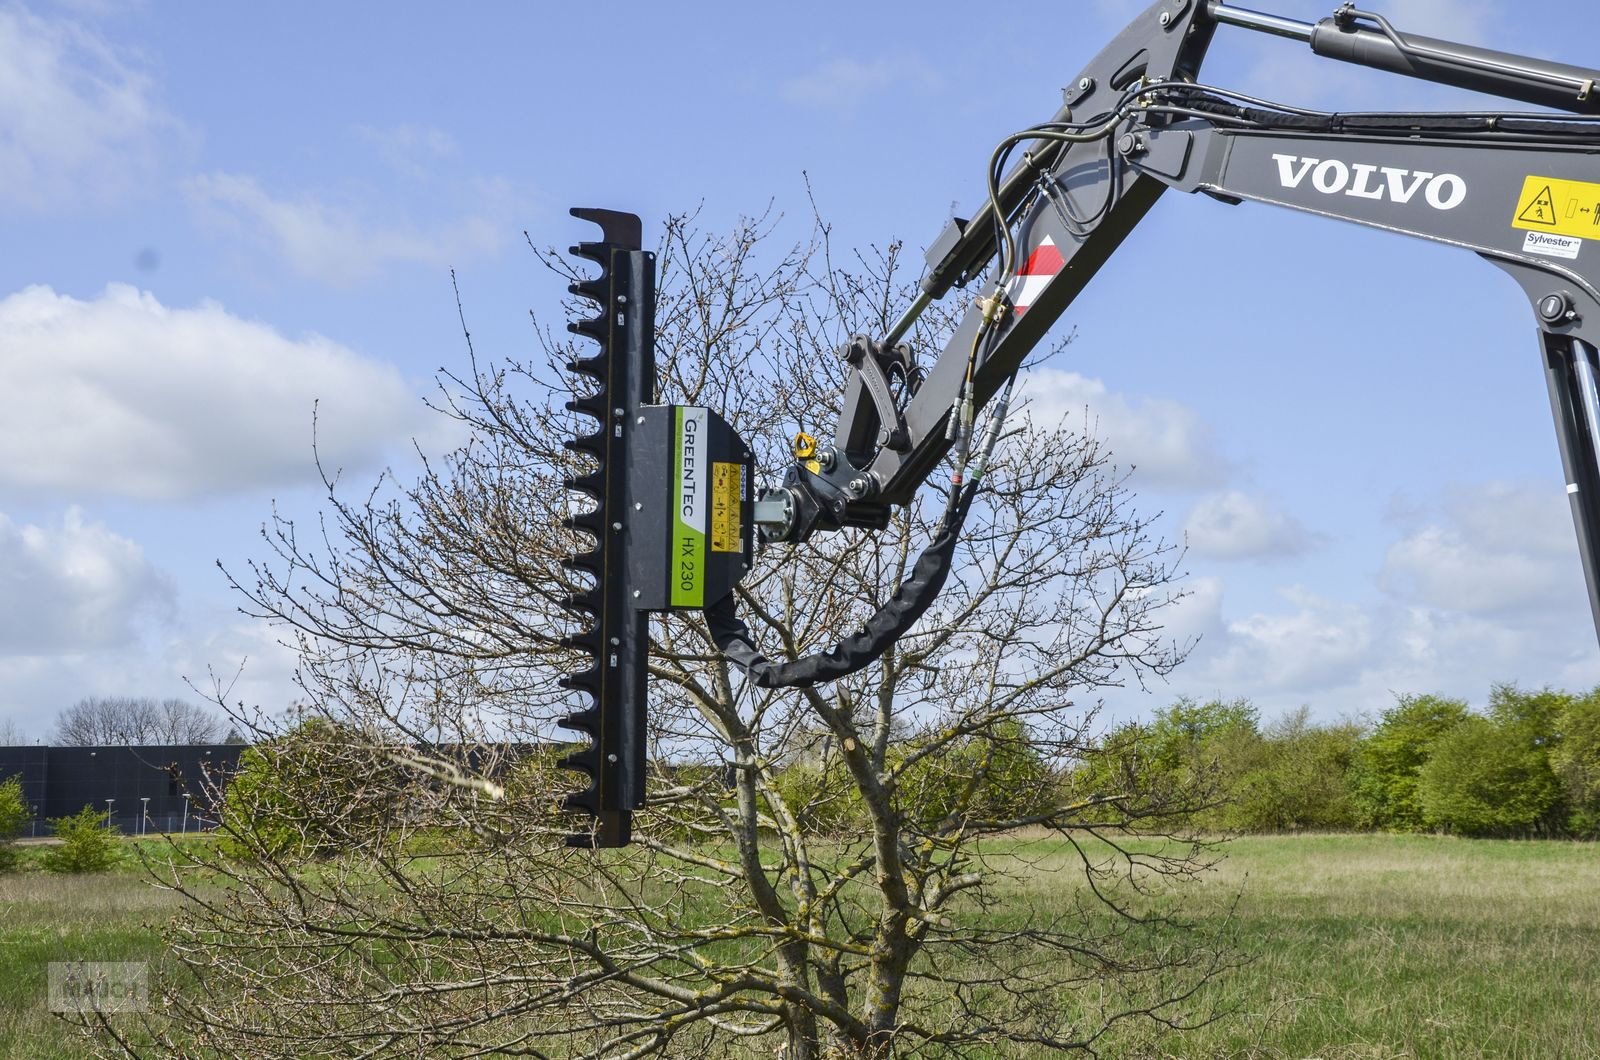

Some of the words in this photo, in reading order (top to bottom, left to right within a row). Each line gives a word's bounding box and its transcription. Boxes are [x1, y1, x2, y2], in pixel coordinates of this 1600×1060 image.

[1272, 153, 1467, 210] VOLVO
[1527, 233, 1572, 247] Sylvester
[682, 537, 694, 557] HX
[681, 561, 694, 591] 230
